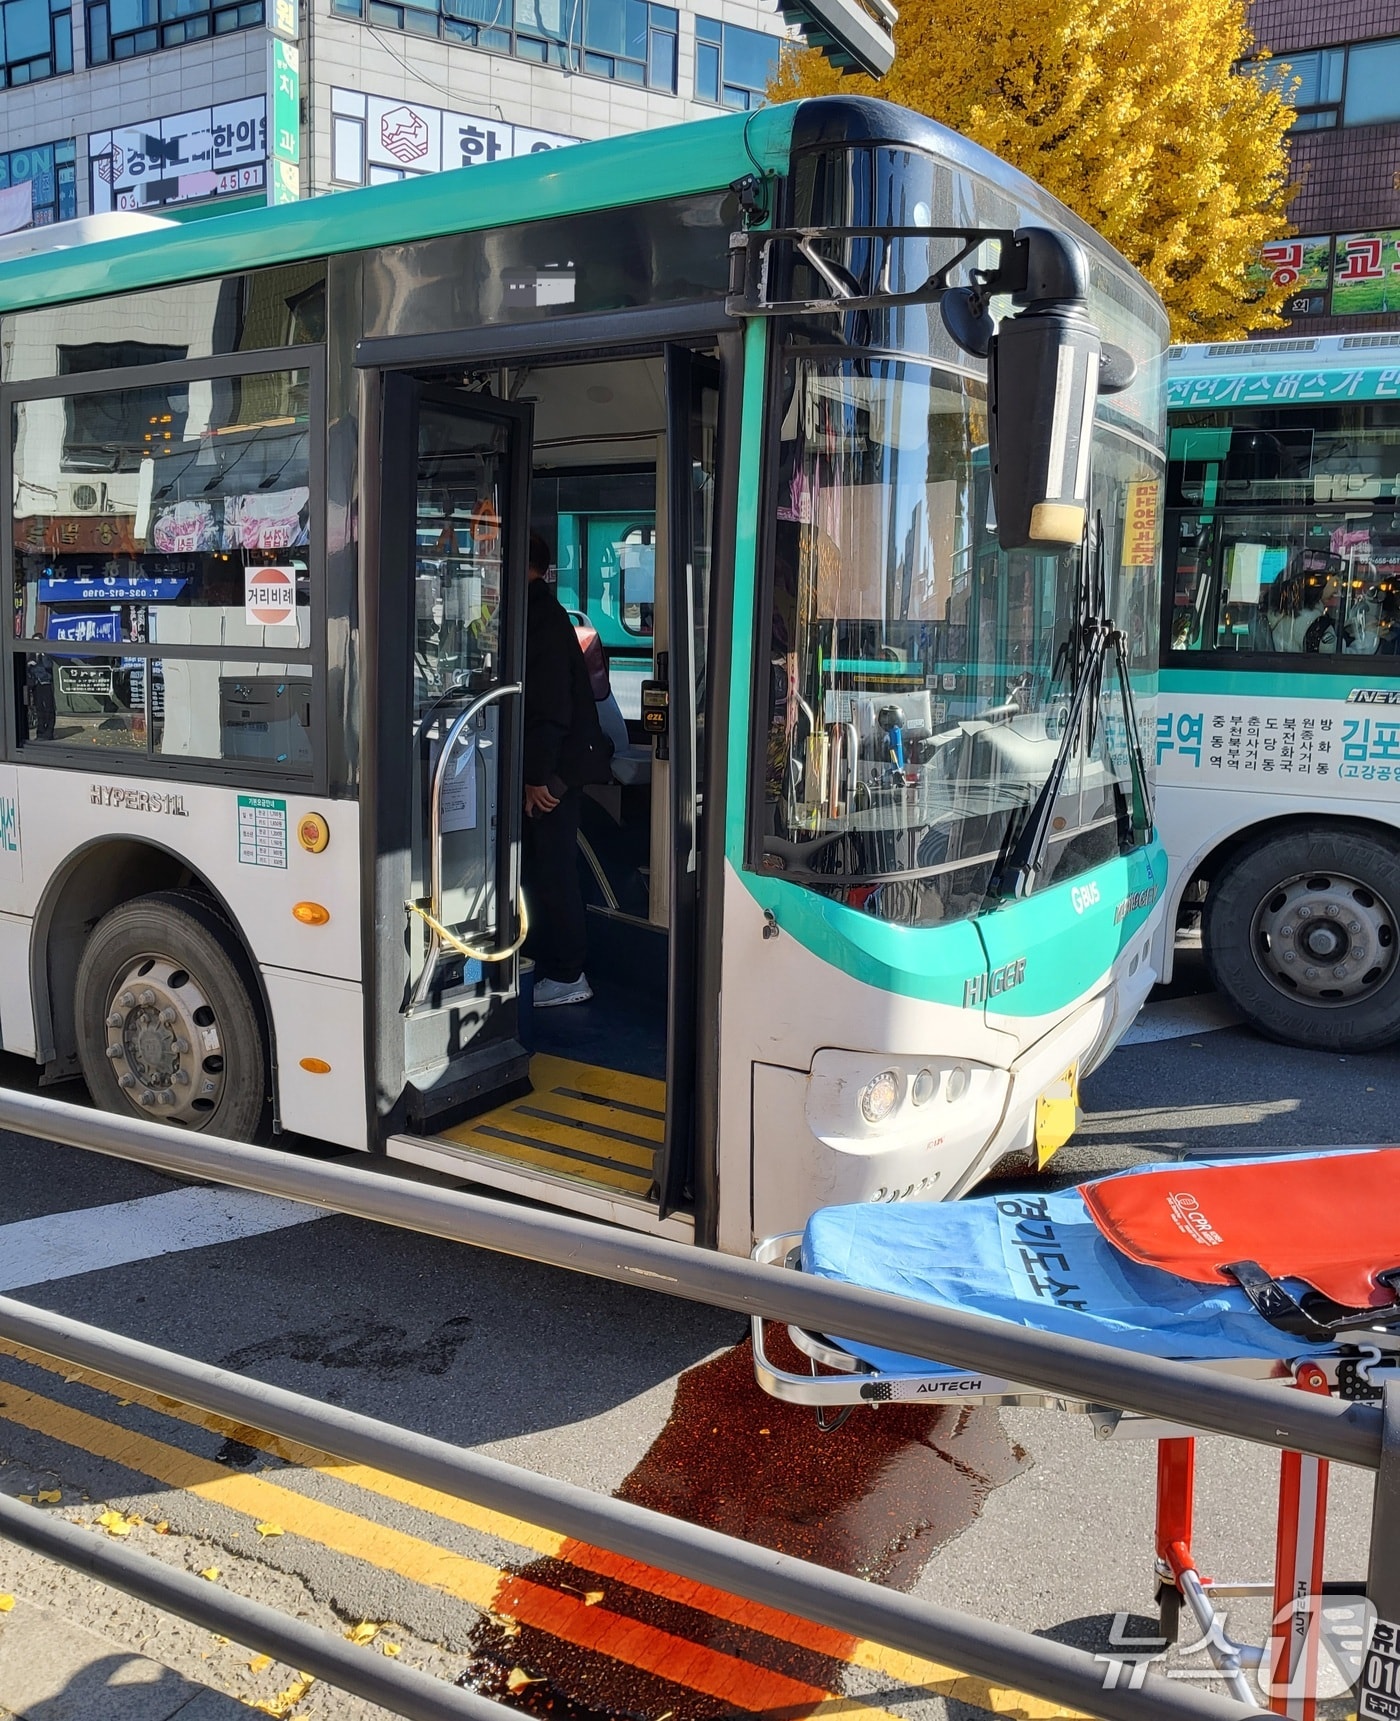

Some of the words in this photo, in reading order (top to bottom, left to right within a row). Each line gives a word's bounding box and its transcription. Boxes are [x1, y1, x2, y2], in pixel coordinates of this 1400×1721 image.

[220, 169, 259, 190] 4591
[247, 586, 295, 606] 거리비례
[1210, 715, 1226, 769] 중동역
[1261, 717, 1279, 773] 도당동
[1315, 718, 1334, 776] 방화동
[963, 956, 1027, 1009] HIGER
[916, 1380, 982, 1394] AUTECH
[1295, 1580, 1307, 1636] AUTECH
[1371, 1623, 1400, 1656] 휴
